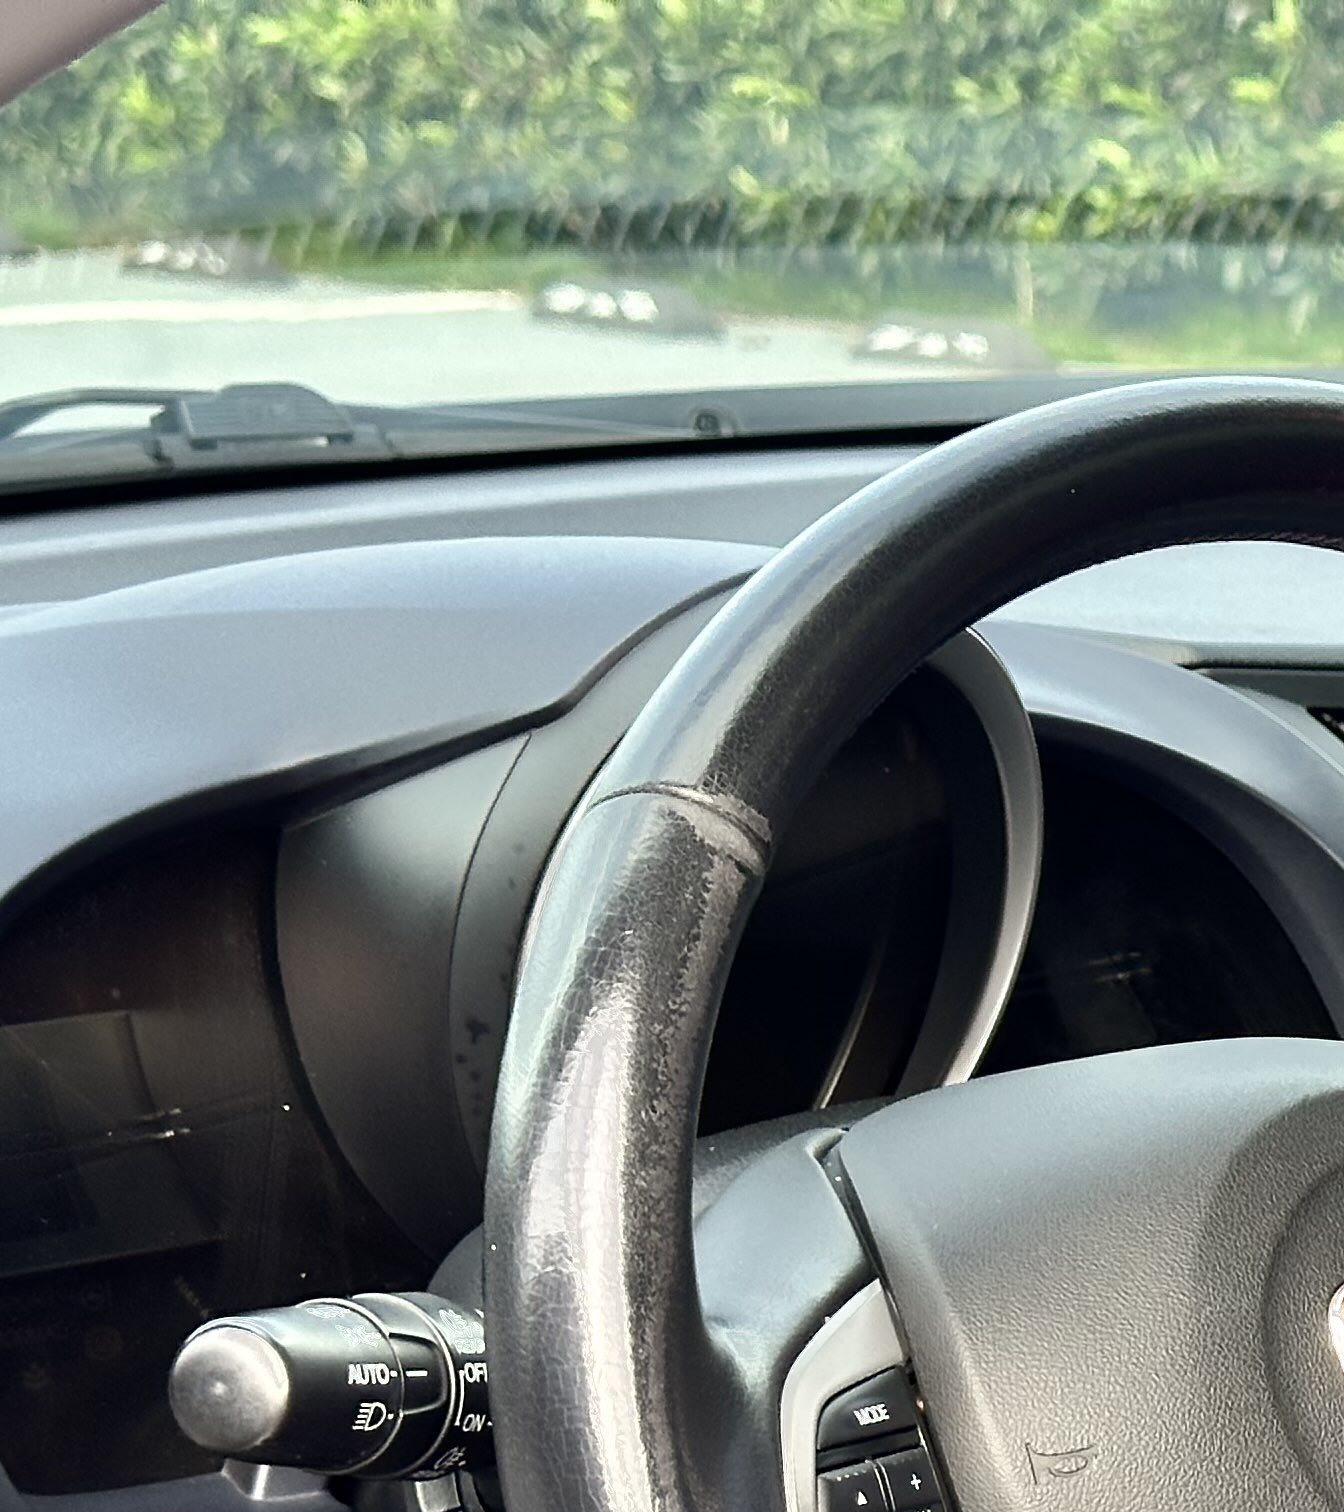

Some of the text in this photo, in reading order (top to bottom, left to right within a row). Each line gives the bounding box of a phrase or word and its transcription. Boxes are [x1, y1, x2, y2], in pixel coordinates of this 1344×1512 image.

[347, 1363, 390, 1386] AUTO
[462, 1413, 487, 1433] ON
[853, 1402, 891, 1427] MODE
